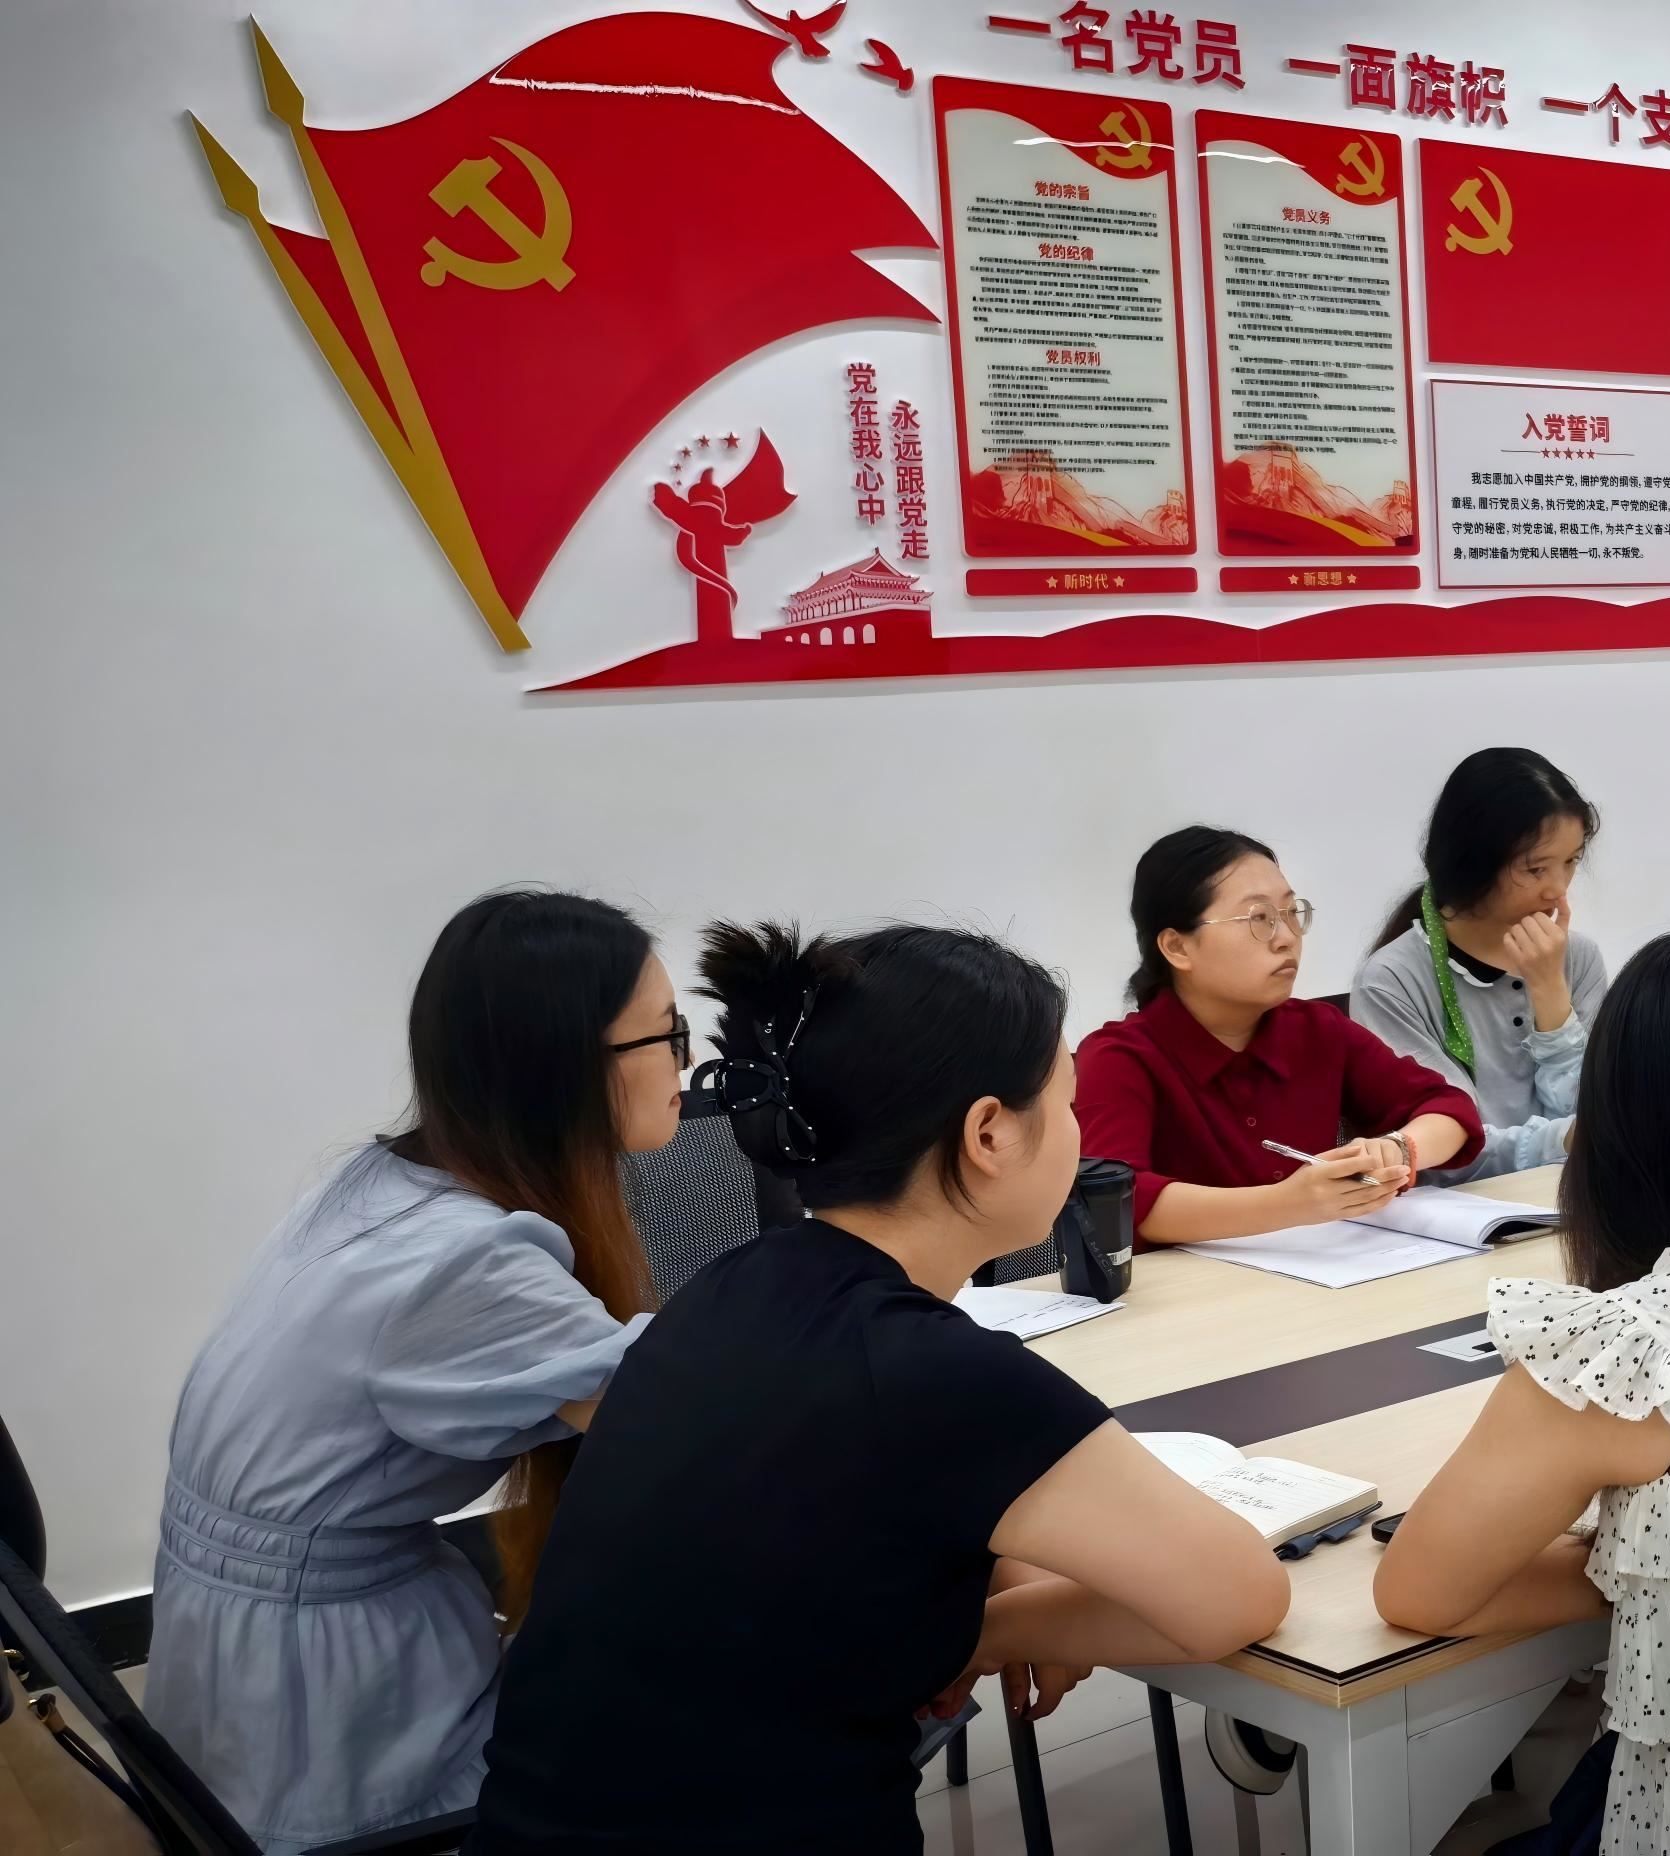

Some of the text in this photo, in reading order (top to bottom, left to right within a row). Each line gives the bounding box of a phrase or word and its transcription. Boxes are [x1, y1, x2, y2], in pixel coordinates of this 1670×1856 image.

[988, 0, 1246, 90] 一名党员
[1287, 43, 1510, 128] 一面旗帜
[1282, 207, 1331, 225] 党员义务
[1038, 242, 1094, 262] 党的纪律
[1046, 349, 1101, 366] 党员权利
[847, 362, 885, 526] 党在我心中
[1522, 412, 1611, 444] 入党誓词
[892, 399, 930, 560] 永远跟党走
